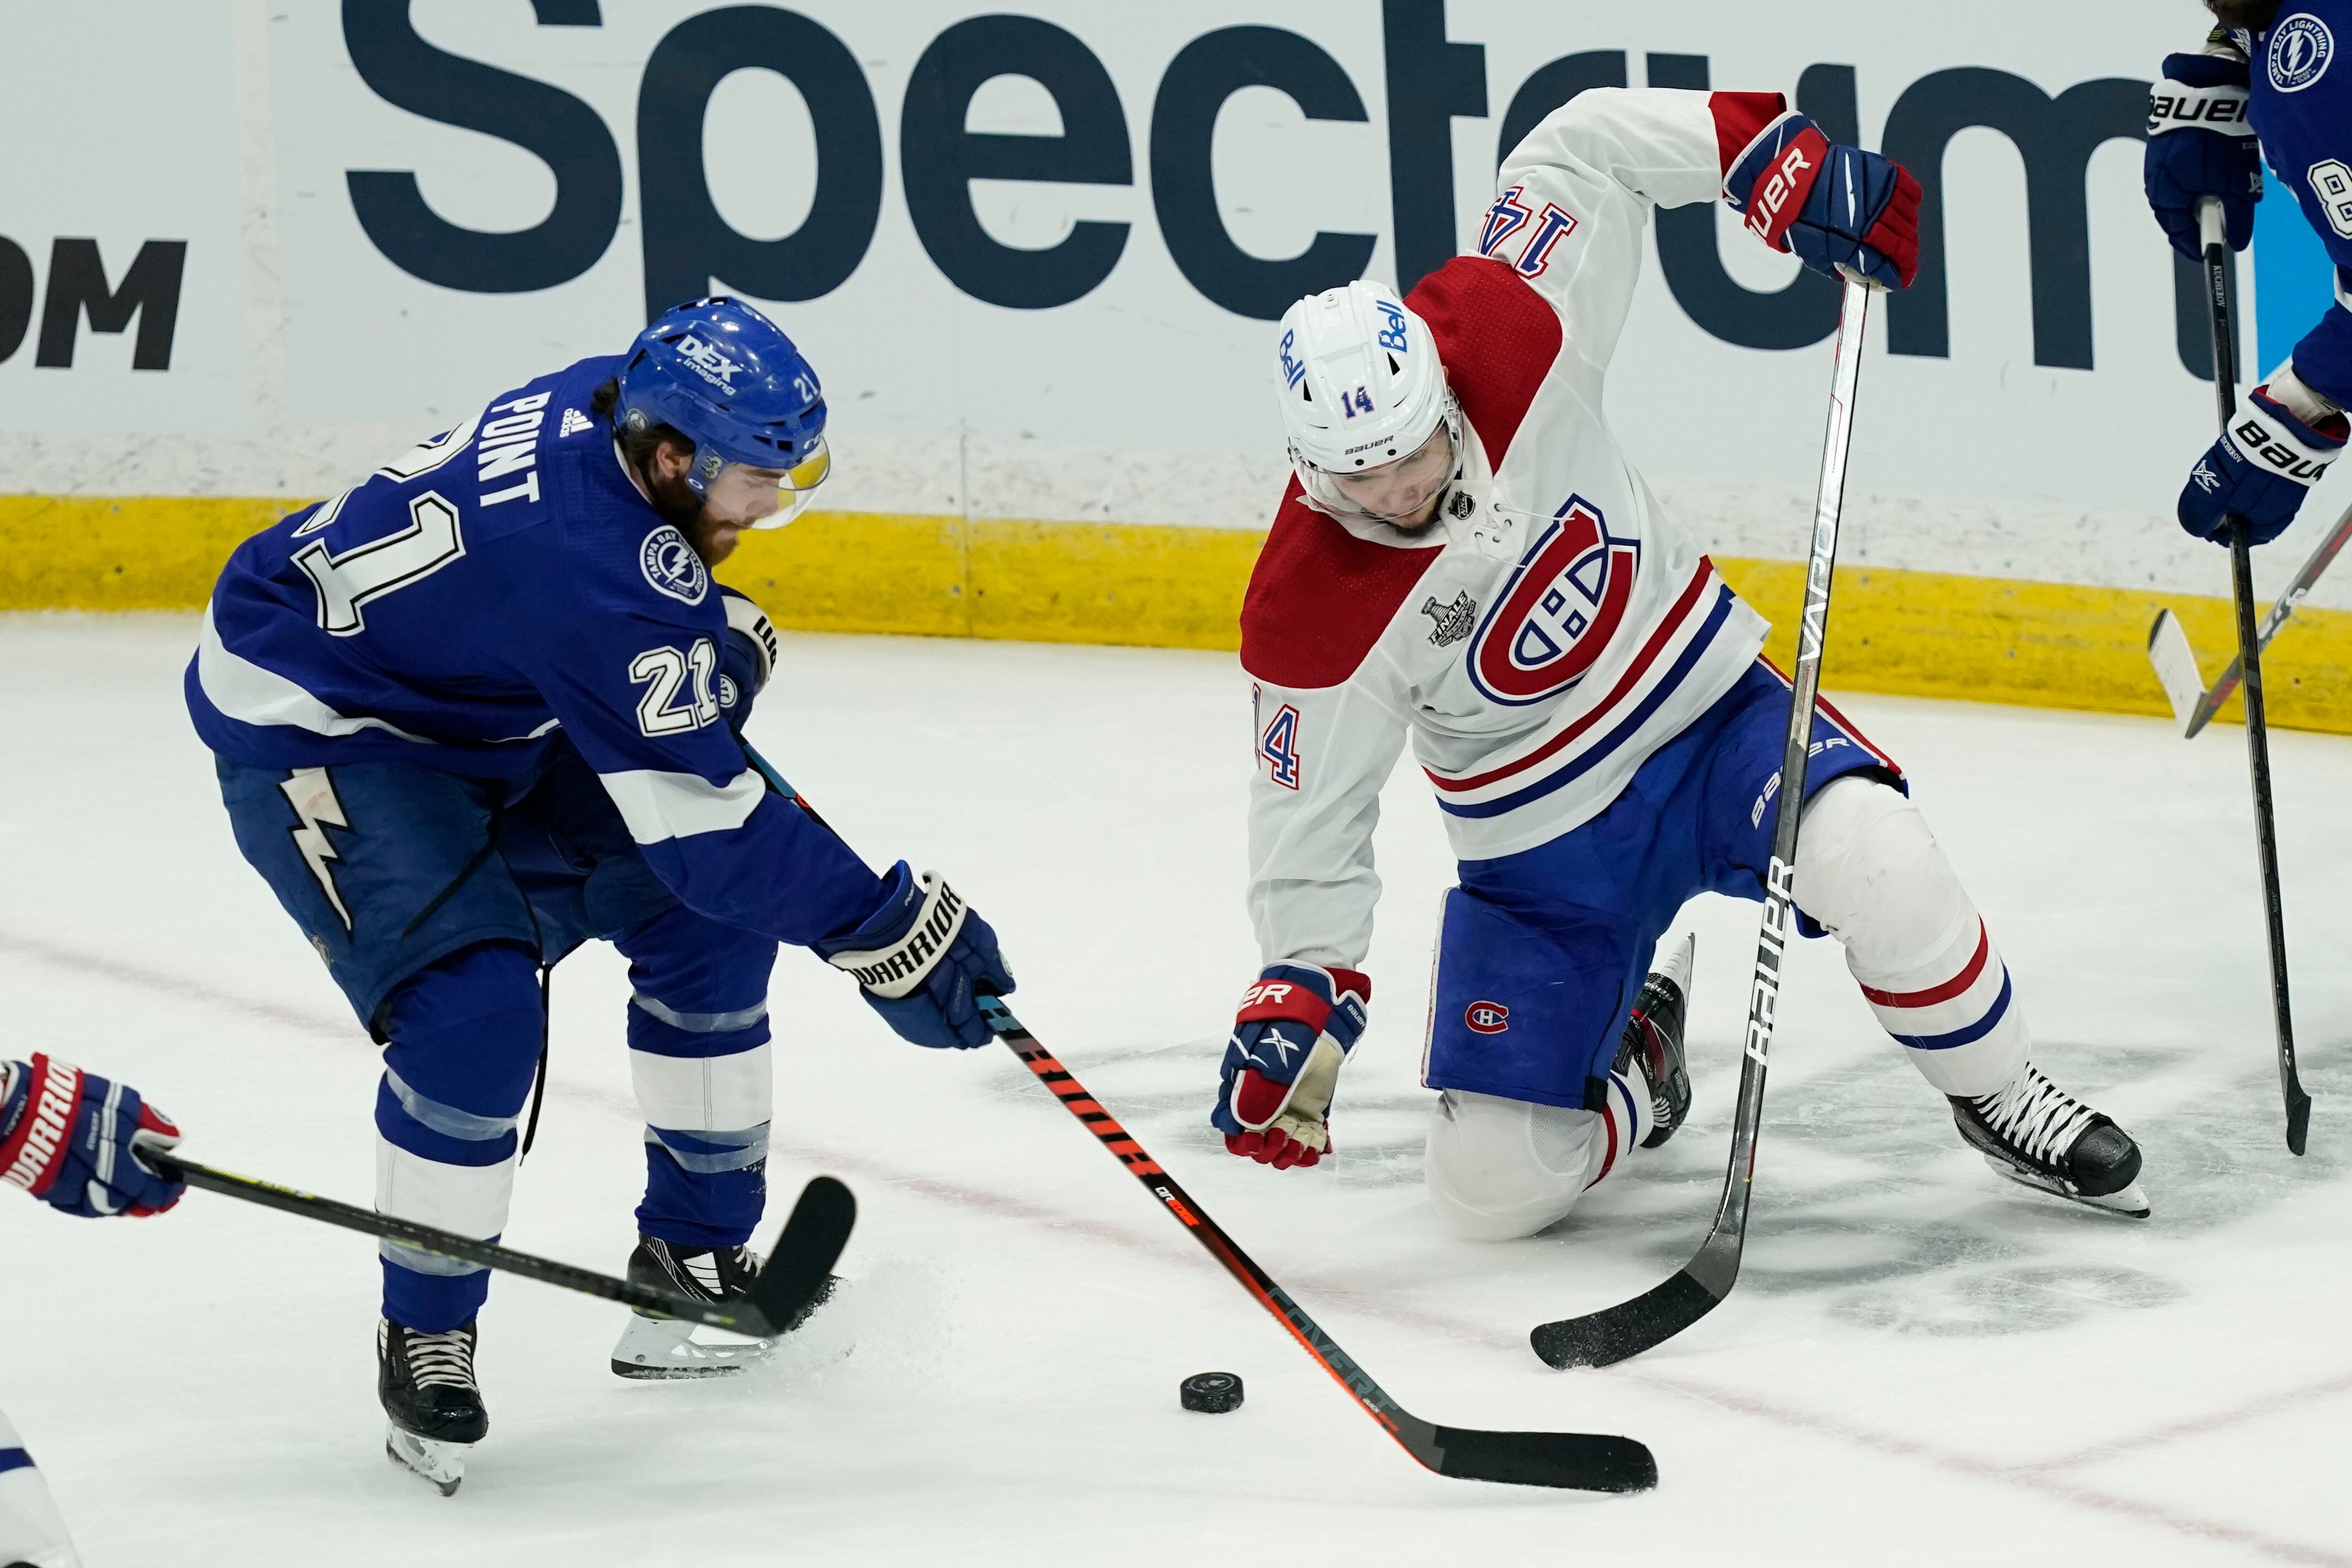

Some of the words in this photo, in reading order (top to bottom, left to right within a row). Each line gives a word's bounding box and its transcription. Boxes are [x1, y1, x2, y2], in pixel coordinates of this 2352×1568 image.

[2274, 28, 2287, 49] BAY
[2289, 20, 2327, 58] LIGHTNING
[2271, 53, 2284, 84] TAMPA
[1749, 148, 1812, 246] UER
[1478, 185, 1579, 280] 14
[1376, 300, 1408, 353] Bell
[676, 334, 742, 383] DEX
[683, 358, 737, 396] imaging
[1279, 328, 1306, 390] Bell
[794, 372, 818, 404] 21
[1341, 386, 1374, 419] 14
[559, 408, 574, 438] adidas
[477, 391, 552, 507] POINT
[2220, 435, 2243, 463] UCHEROV
[646, 543, 662, 580] TAMPA
[656, 531, 677, 544] BAY
[1430, 592, 1468, 642] FINALE
[628, 637, 719, 737] 21
[851, 881, 962, 986] WARRIOR
